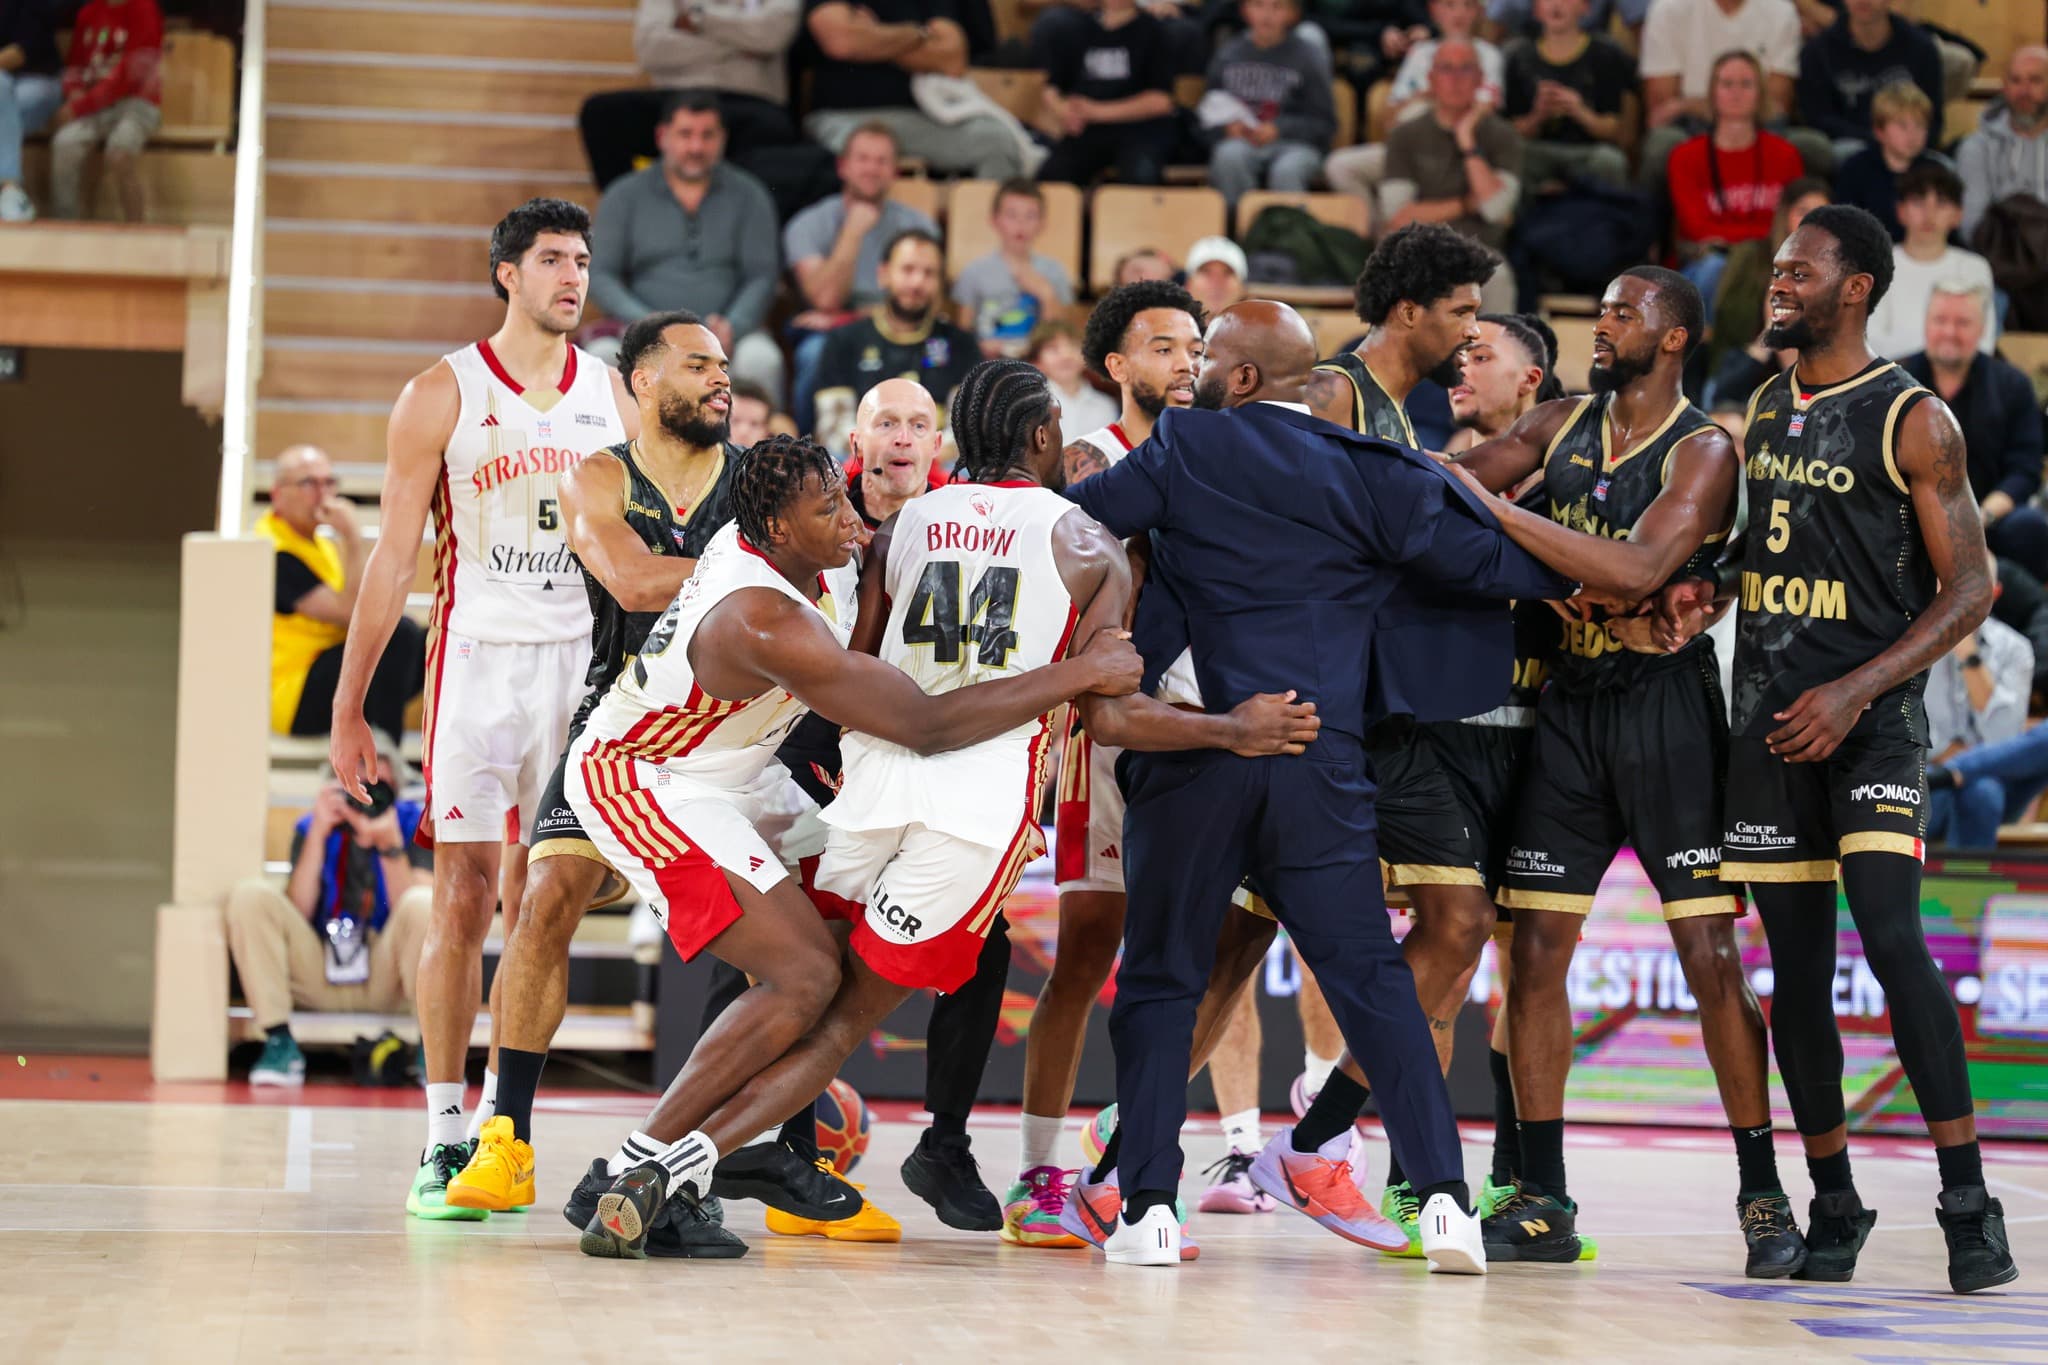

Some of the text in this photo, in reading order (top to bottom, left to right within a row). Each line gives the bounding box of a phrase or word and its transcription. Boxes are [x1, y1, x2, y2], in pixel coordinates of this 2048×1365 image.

[472, 447, 583, 498] STRASBO
[538, 499, 559, 531] 5
[629, 501, 661, 519] SPALDING
[1766, 498, 1790, 553] 5
[927, 521, 1016, 557] BROWN
[489, 543, 580, 574] Stradi
[902, 560, 1022, 670] 44
[1875, 803, 1913, 818] SPALDING
[877, 893, 922, 938] LCR
